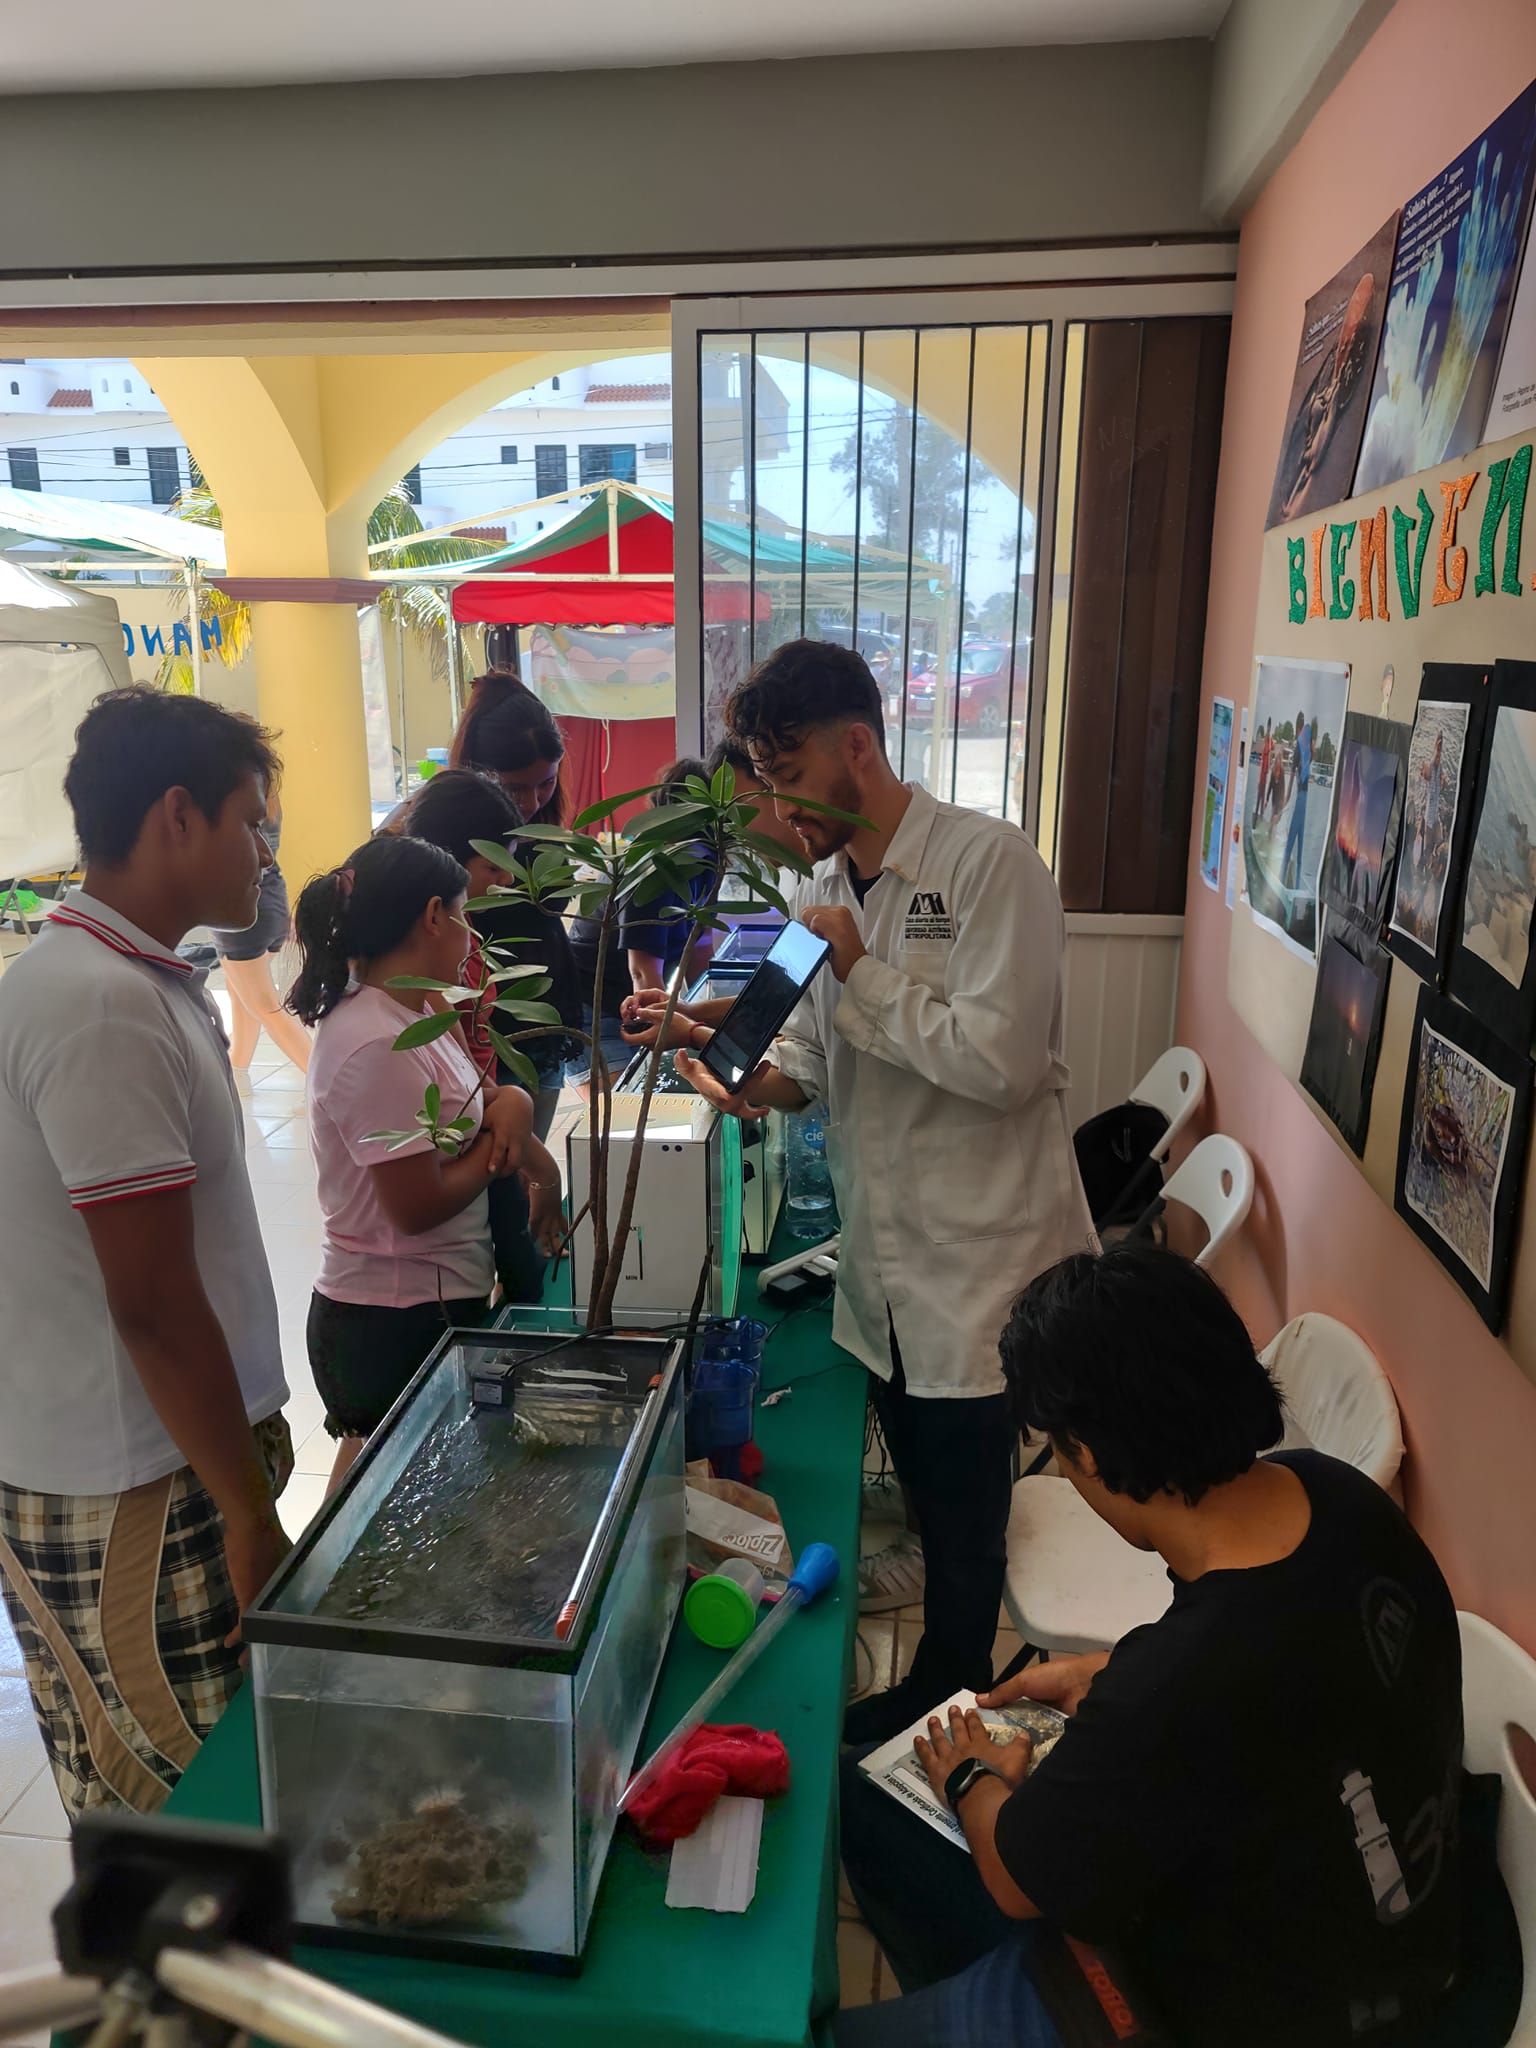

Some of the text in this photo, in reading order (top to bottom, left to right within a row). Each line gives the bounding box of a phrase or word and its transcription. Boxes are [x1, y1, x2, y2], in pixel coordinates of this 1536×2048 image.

[1287, 444, 1536, 625] BIENVEN
[804, 1128, 824, 1142] cie
[726, 1532, 781, 1556] Ziploc
[886, 1775, 909, 1795] Adopción
[906, 1791, 916, 1799] de
[912, 1795, 938, 1816] Certificado
[934, 1812, 957, 1832] presente
